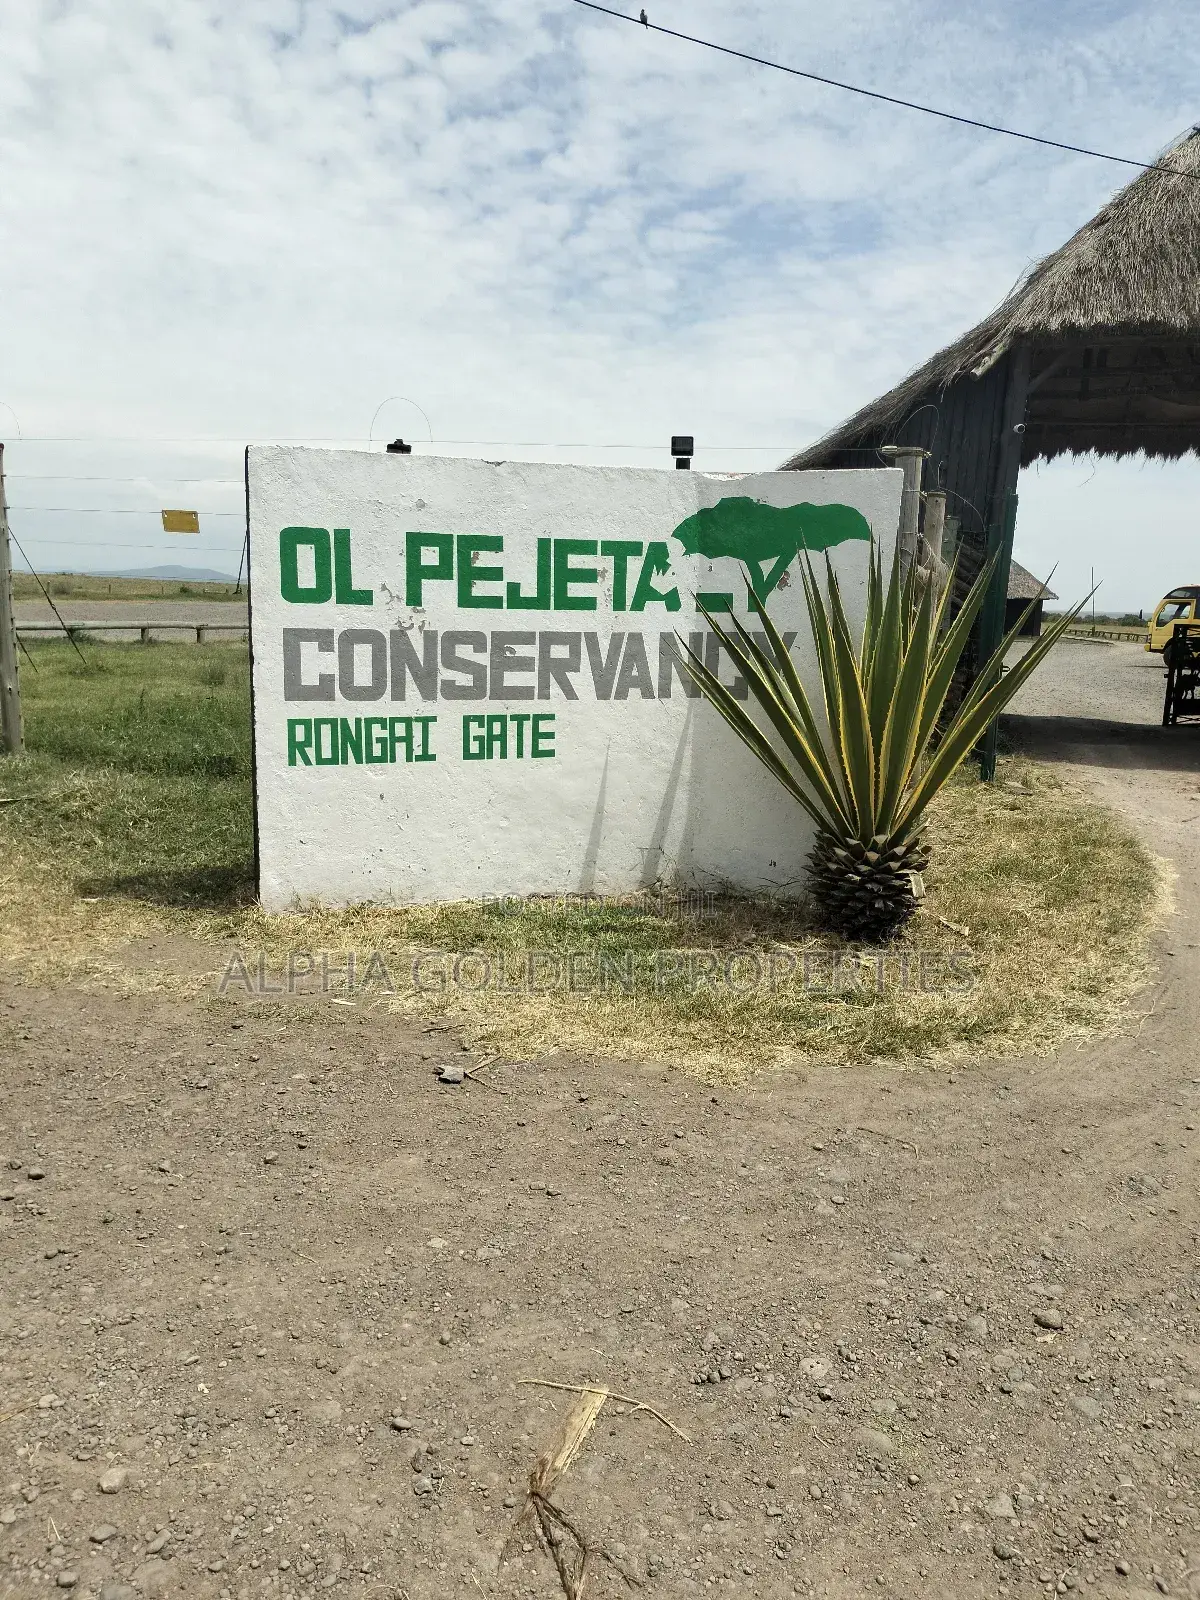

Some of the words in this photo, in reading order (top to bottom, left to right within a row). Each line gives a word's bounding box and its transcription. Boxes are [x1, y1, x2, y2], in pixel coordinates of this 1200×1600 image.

[280, 527, 373, 606] OL
[406, 532, 682, 612] PEJETA
[288, 715, 437, 767] RONGAI
[463, 714, 556, 760] GATE
